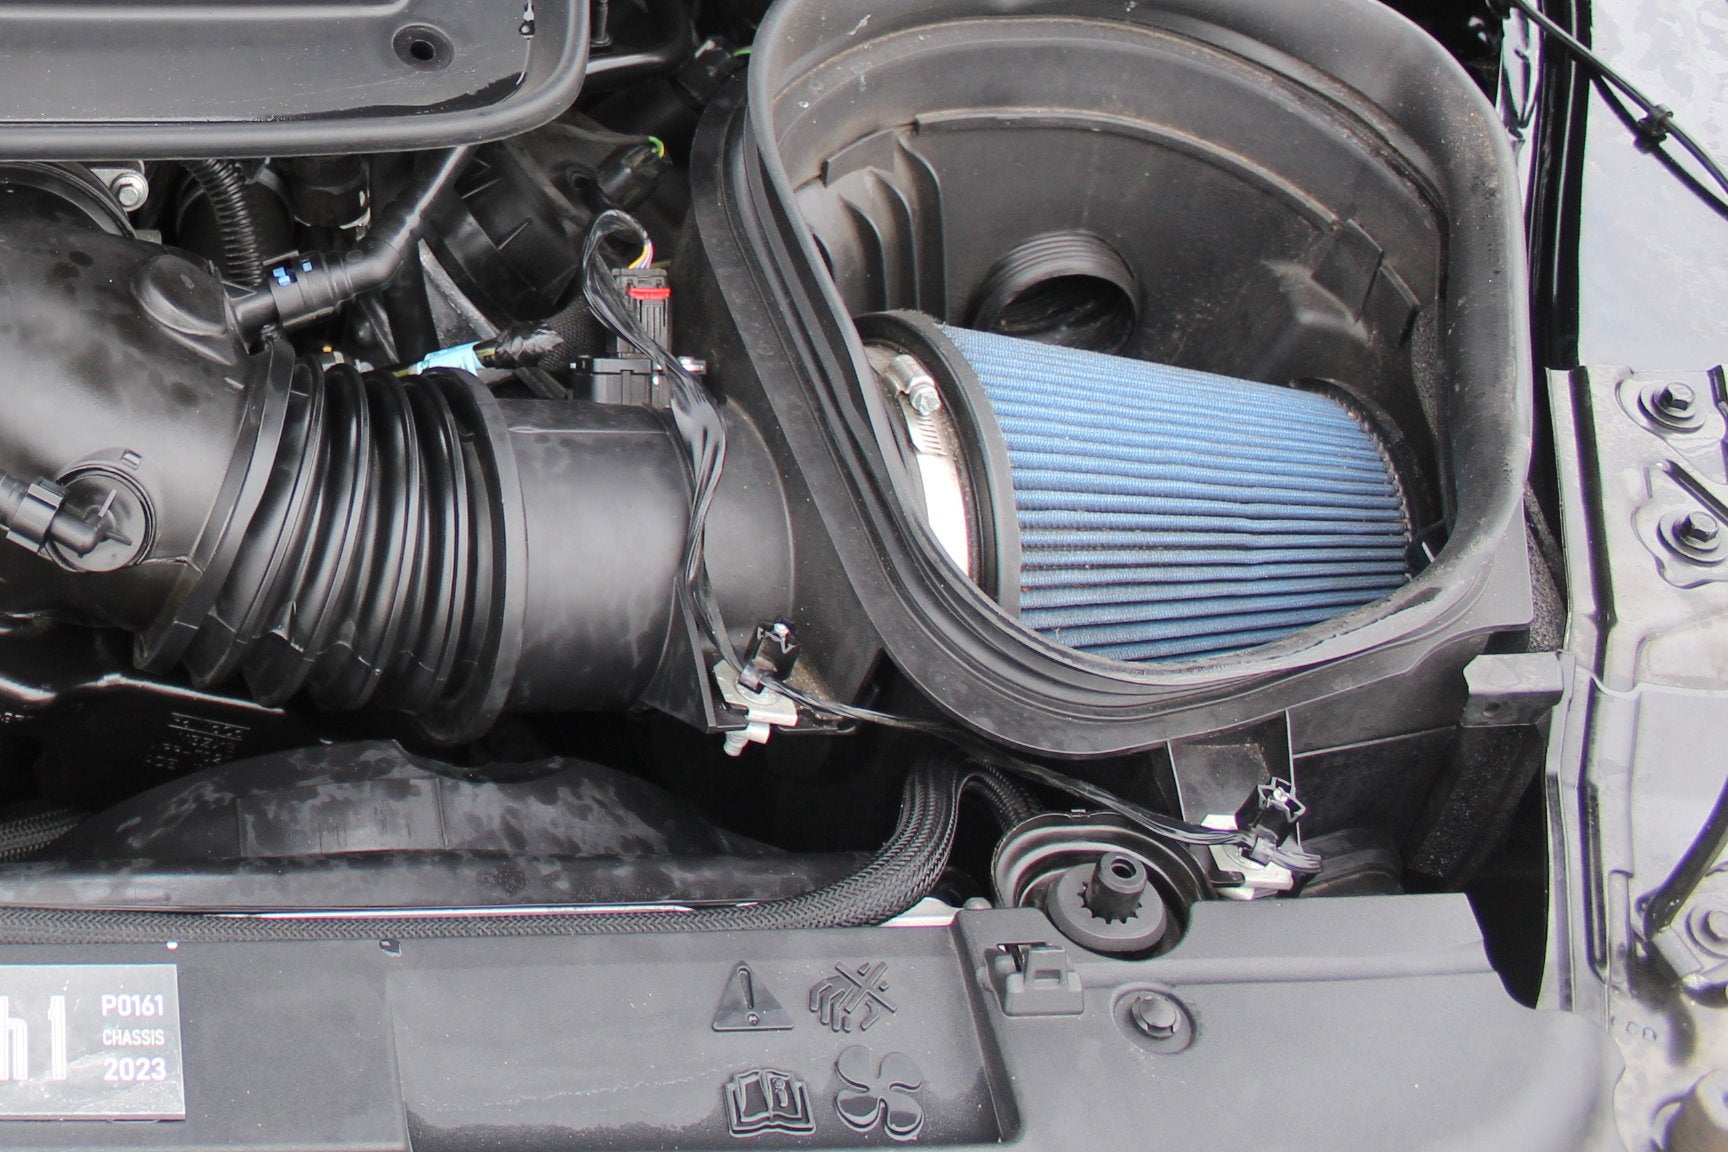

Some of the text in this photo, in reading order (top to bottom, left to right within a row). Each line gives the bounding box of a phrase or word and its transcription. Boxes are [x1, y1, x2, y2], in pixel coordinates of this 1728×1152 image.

[101, 994, 164, 1017] P0161
[47, 995, 67, 1081] 1
[102, 1029, 166, 1047] CHASSIS
[103, 1057, 167, 1082] 2023
